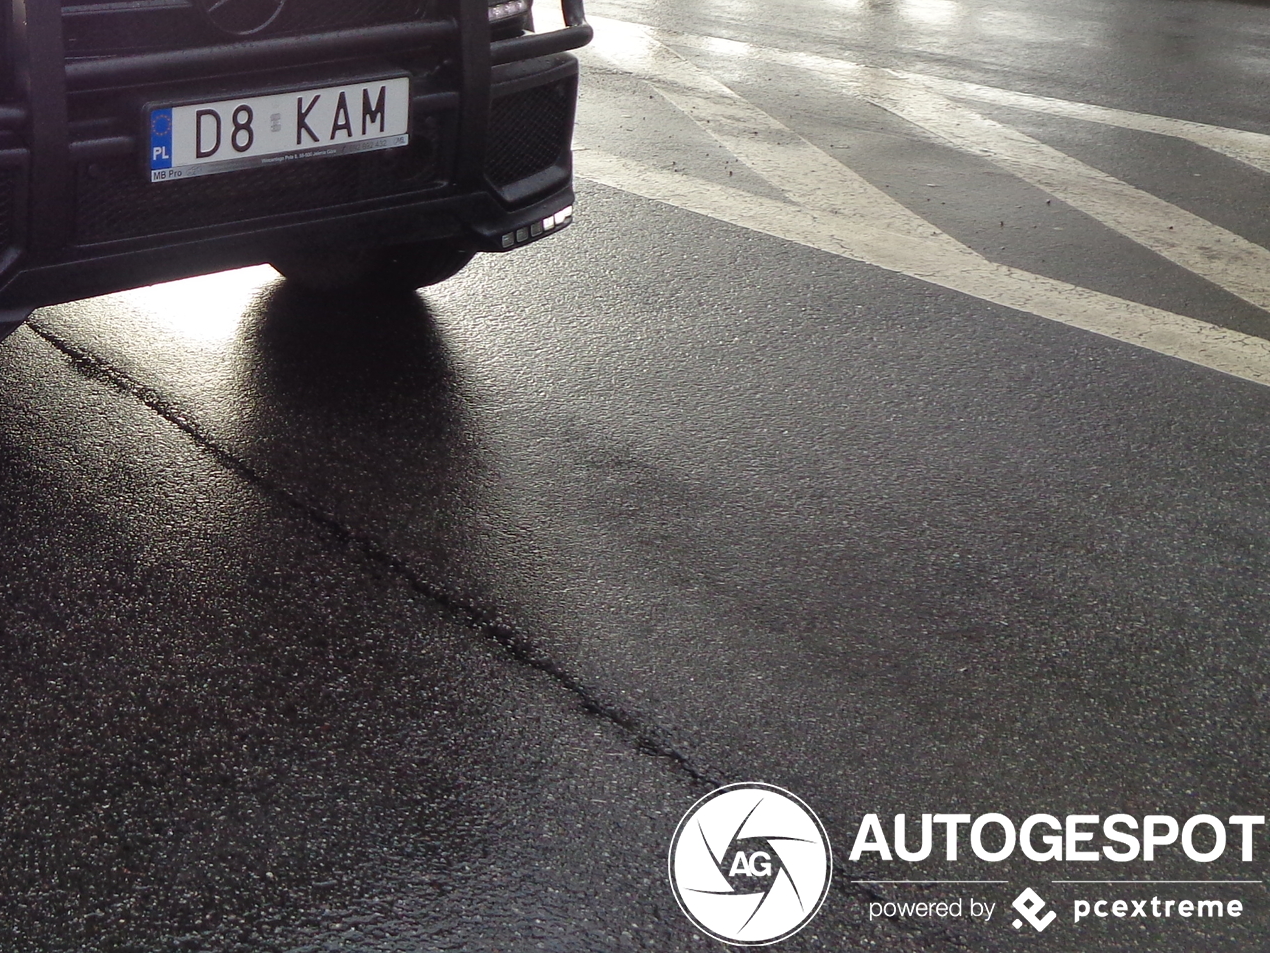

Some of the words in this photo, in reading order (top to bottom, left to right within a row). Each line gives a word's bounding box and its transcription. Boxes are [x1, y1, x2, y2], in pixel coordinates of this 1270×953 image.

[195, 104, 254, 159] D8
[296, 85, 387, 146] KAM
[153, 146, 170, 161] PL
[153, 170, 167, 181] MB
[169, 169, 183, 178] Pro
